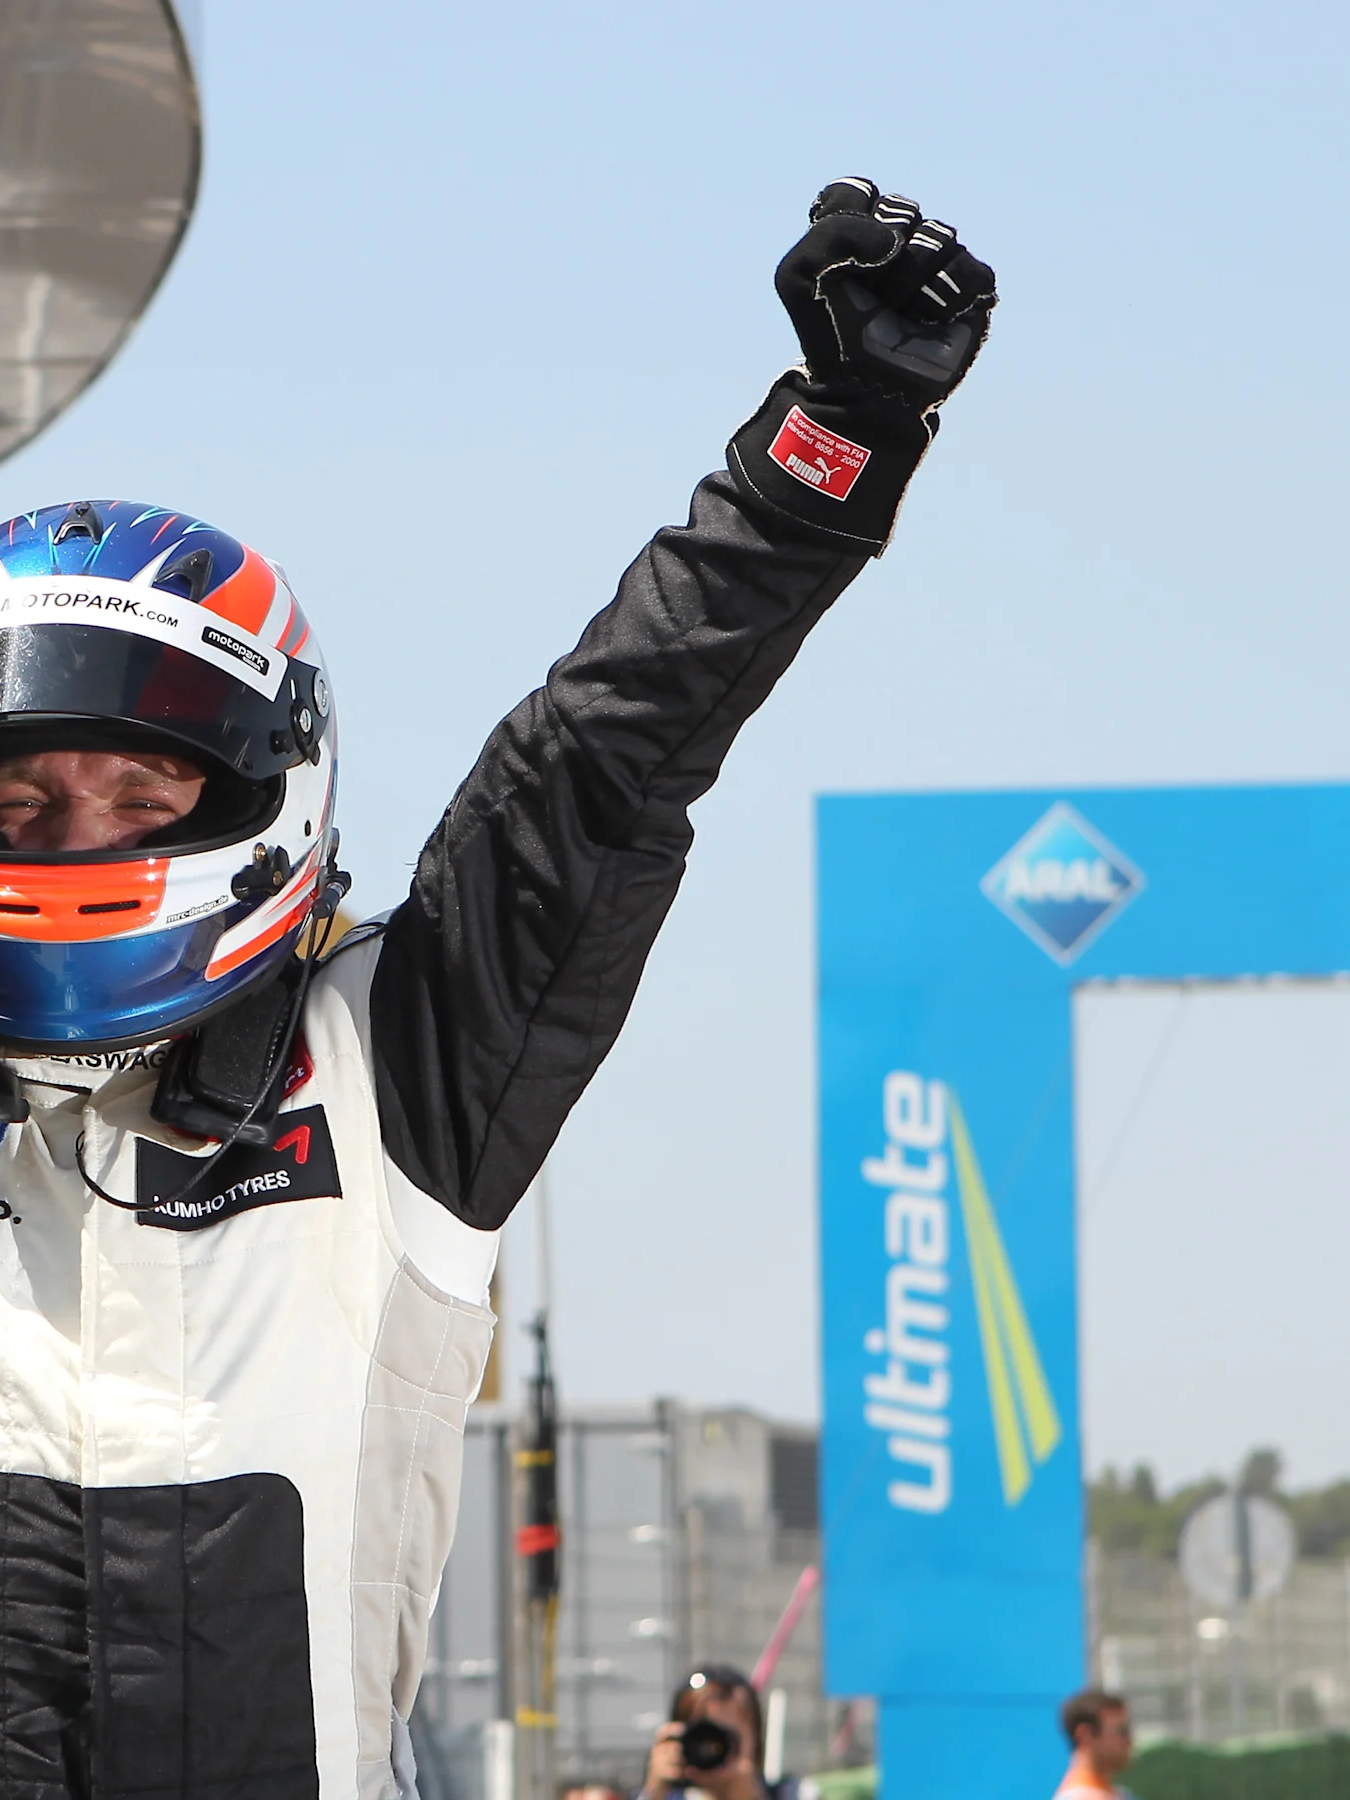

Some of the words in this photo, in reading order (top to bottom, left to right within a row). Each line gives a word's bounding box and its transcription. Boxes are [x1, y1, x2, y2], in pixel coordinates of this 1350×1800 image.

[787, 421, 814, 445] standard
[840, 455, 861, 469] 2000
[797, 419, 836, 446] compliance
[835, 441, 851, 454] with
[851, 449, 865, 461] FIA
[785, 452, 825, 486] PUMA
[208, 631, 265, 668] motopark
[1003, 857, 1124, 902] ARAL
[166, 894, 229, 924] mrc-design.de
[225, 1168, 291, 1202] TYRES
[861, 1069, 951, 1516] ultimate
